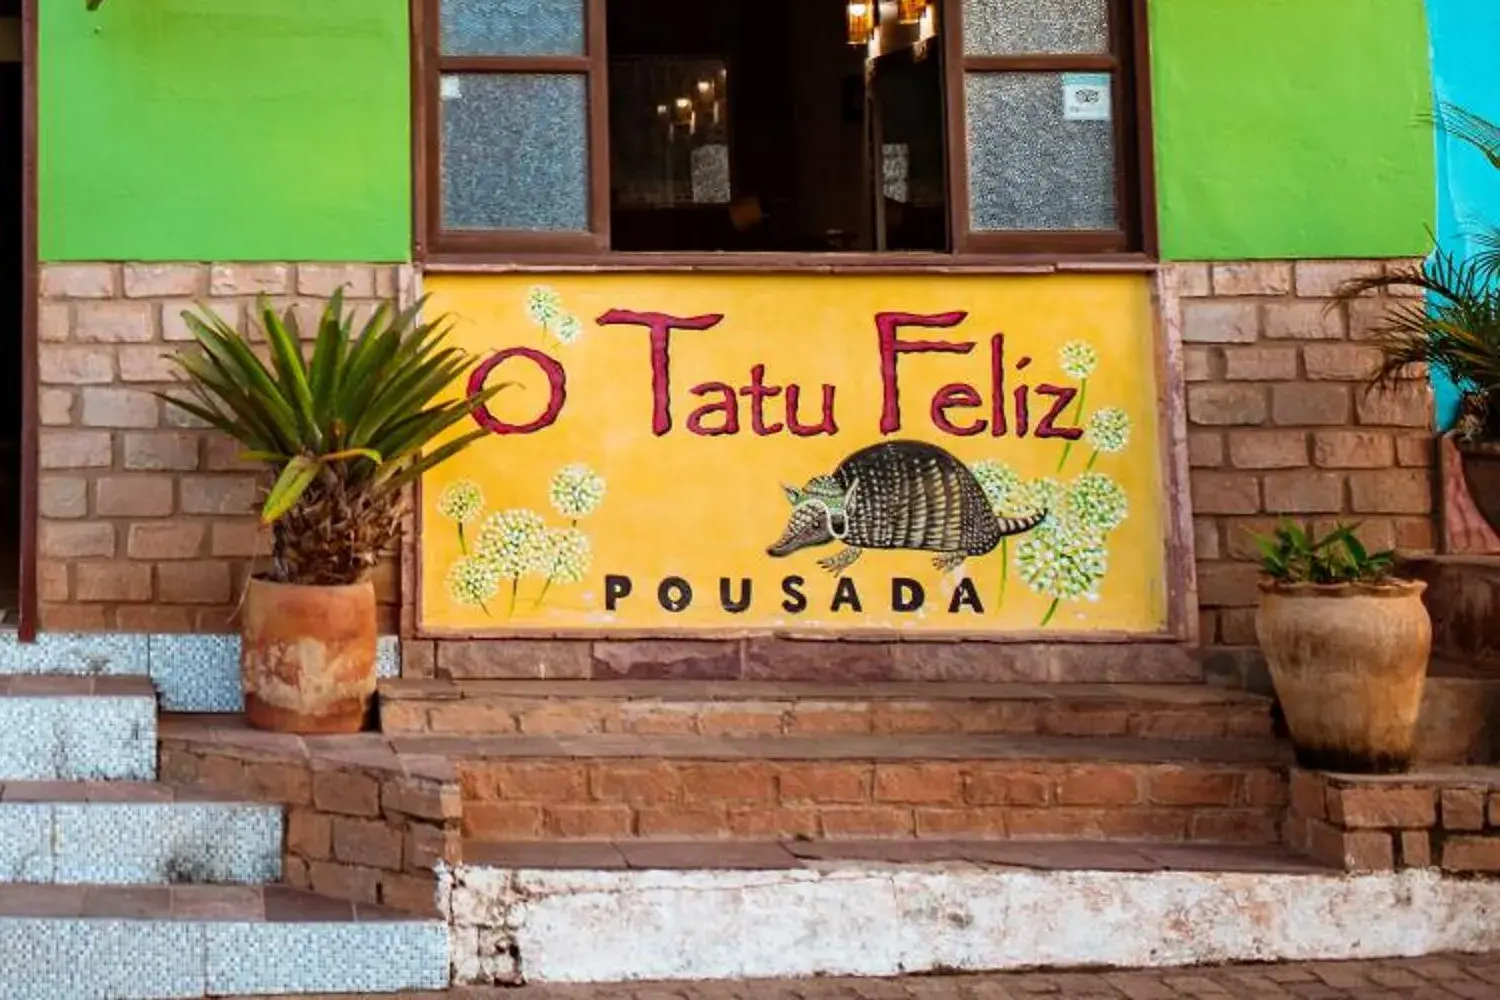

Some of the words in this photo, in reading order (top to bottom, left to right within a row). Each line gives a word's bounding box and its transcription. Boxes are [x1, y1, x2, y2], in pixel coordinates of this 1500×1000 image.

[466, 346, 567, 435] O
[596, 309, 839, 436] Tatu
[605, 574, 985, 613] POUSADA
